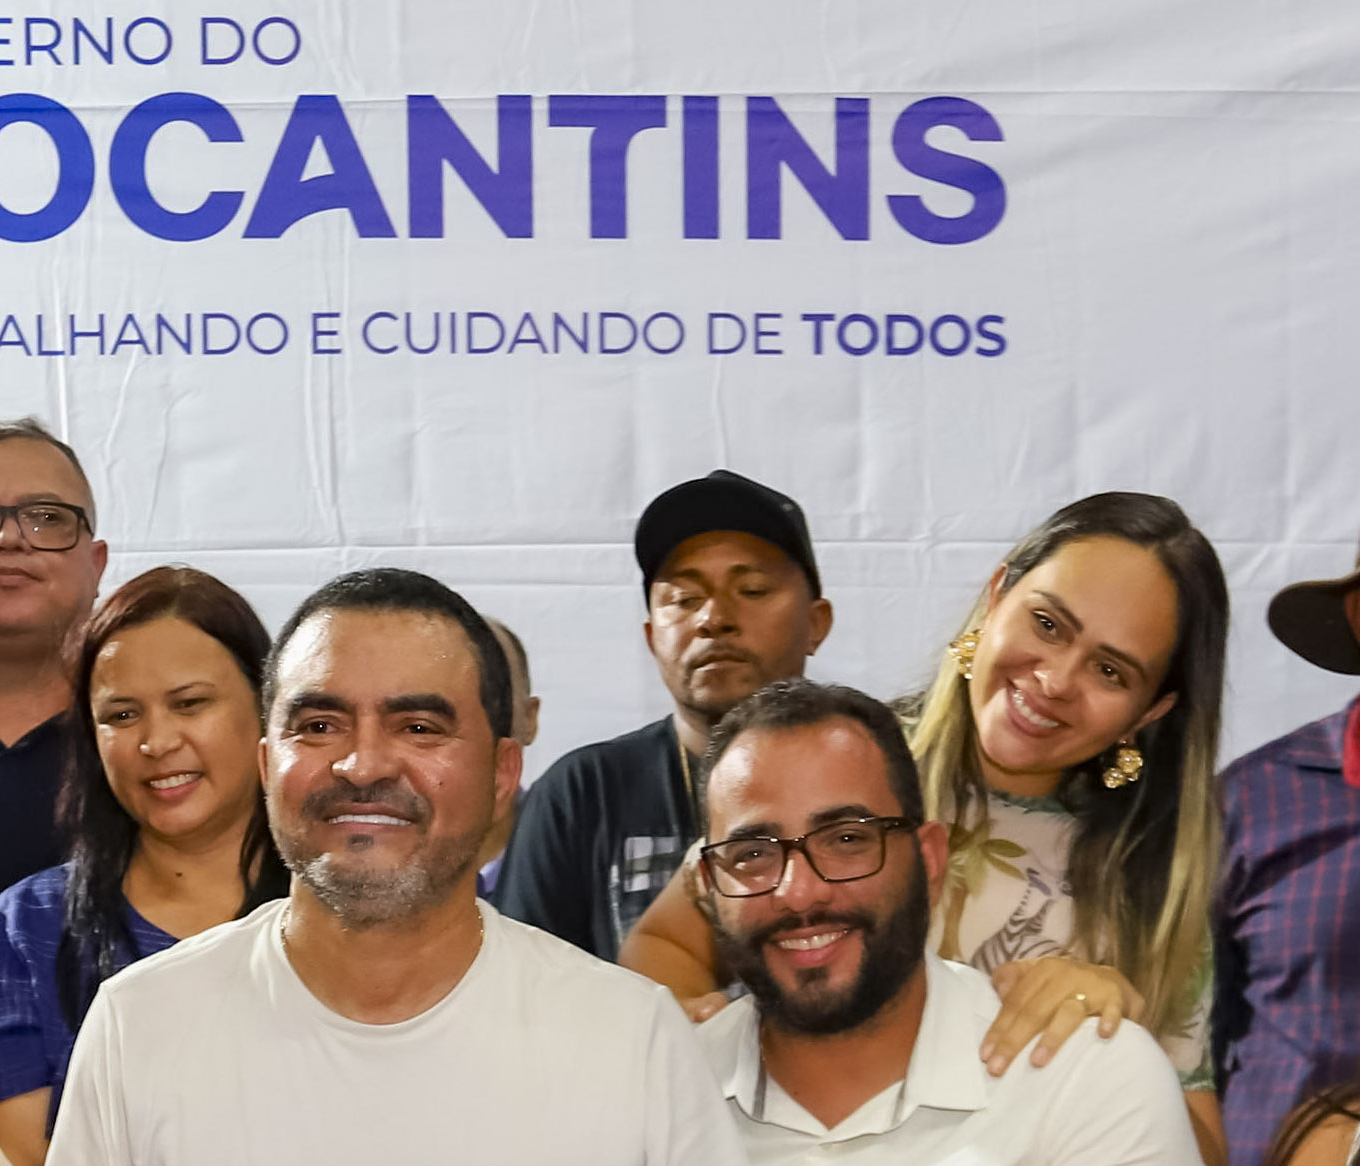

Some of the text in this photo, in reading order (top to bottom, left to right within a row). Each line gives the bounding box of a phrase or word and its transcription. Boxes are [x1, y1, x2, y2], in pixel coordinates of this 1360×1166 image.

[199, 16, 302, 67] DO
[311, 312, 342, 356] E
[361, 311, 686, 357] CUIDANDO
[707, 312, 784, 356] DE
[801, 311, 1008, 358] TODOS
